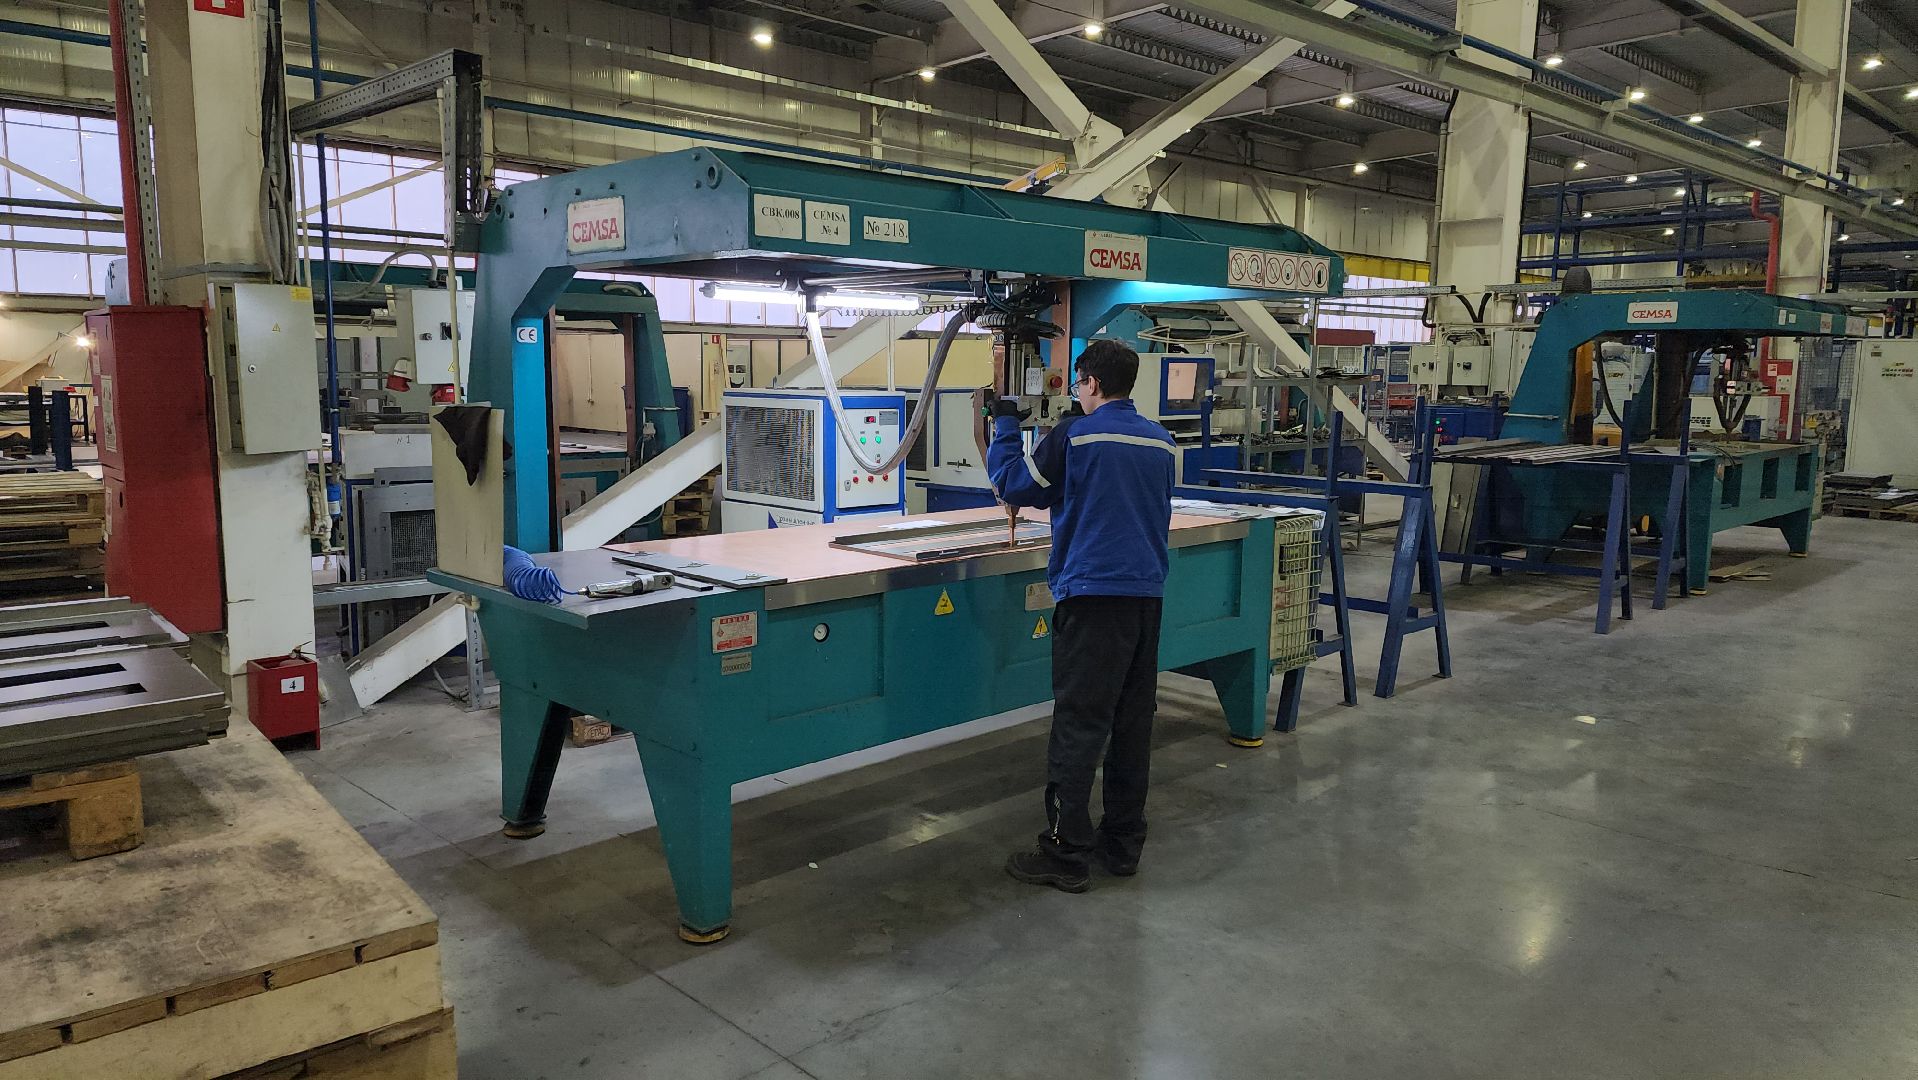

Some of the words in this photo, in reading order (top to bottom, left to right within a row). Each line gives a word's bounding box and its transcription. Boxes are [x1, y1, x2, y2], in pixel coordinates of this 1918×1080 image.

[813, 209, 847, 222] CEMSA
[573, 217, 620, 243] CEMSA
[833, 226, 839, 236] 4
[1090, 248, 1142, 271] CEMSA
[1631, 309, 1673, 319] CEMSA
[518, 328, 536, 342] CE
[289, 679, 297, 690] 4
